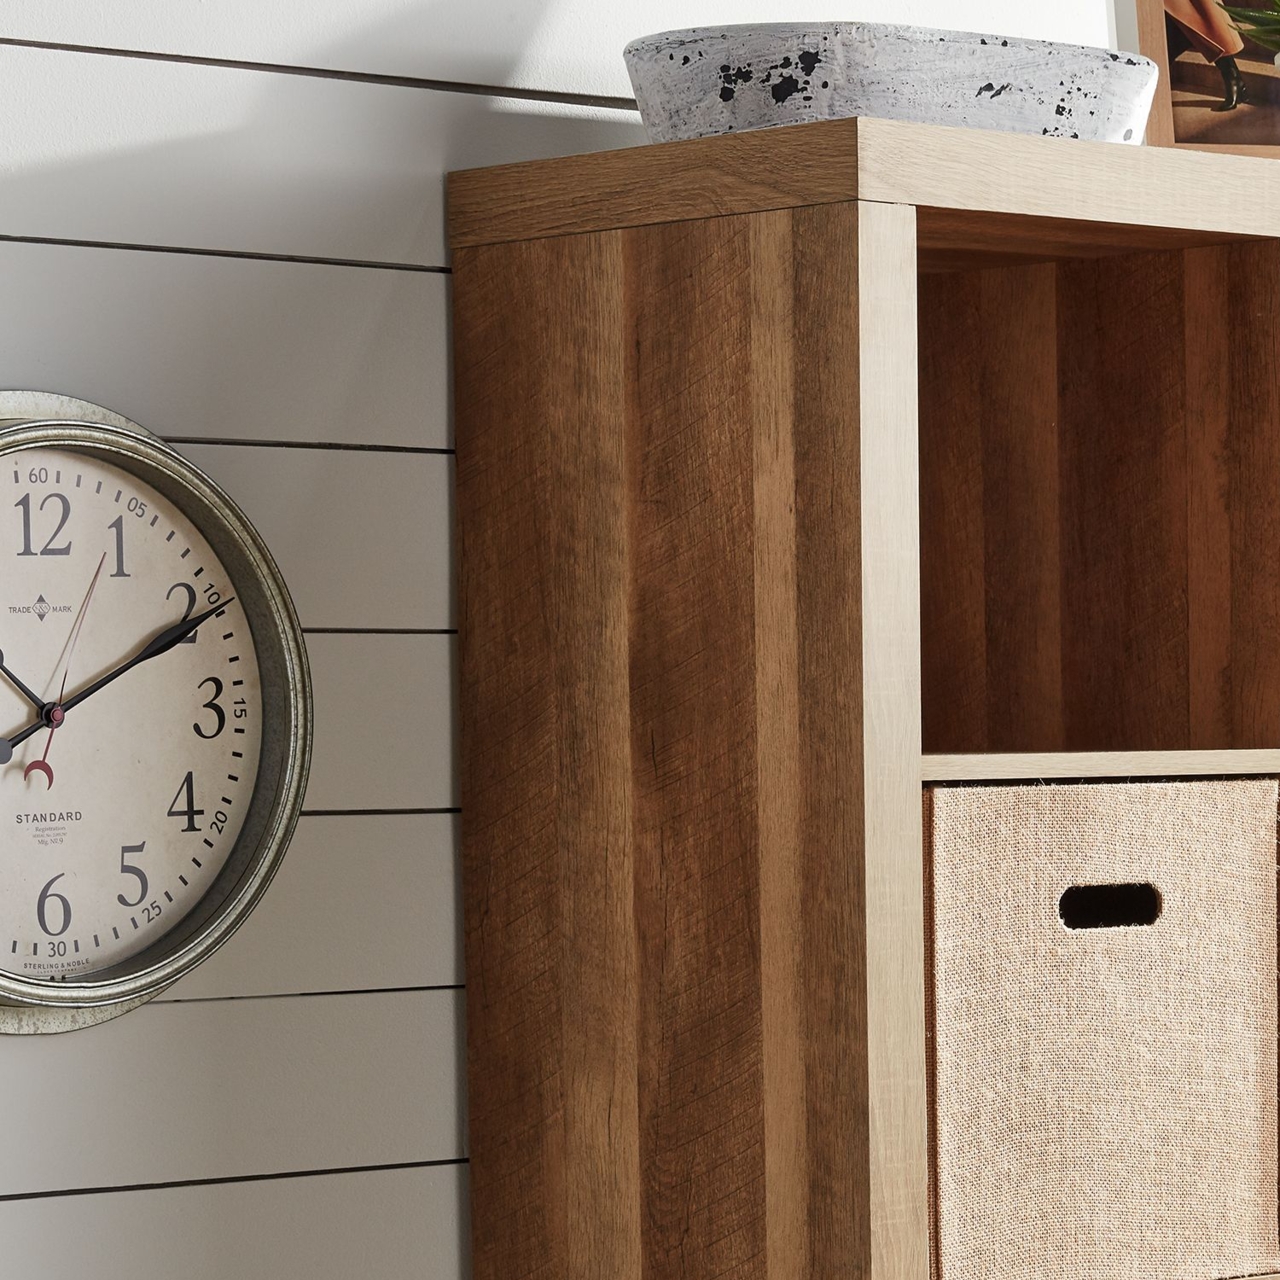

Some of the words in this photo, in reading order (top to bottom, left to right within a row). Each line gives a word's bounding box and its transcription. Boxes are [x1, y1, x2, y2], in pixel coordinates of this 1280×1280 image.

[28, 467, 49, 484] 60
[127, 497, 148, 518] 05
[14, 492, 72, 556] 12
[107, 514, 131, 578] 1
[203, 582, 221, 605] 10
[8, 606, 32, 614] TRADE
[52, 605, 72, 613] MARK
[165, 582, 198, 644] 2
[193, 676, 226, 739] 3
[233, 697, 247, 719] 15
[166, 771, 205, 832] 4
[15, 811, 82, 824] STANDARD
[209, 810, 228, 836] 20
[116, 840, 149, 907] 5
[36, 872, 72, 937] 6
[141, 900, 163, 924] 25
[47, 940, 67, 958] 30
[23, 962, 59, 970] STERLING
[66, 957, 90, 968] NOBLE
